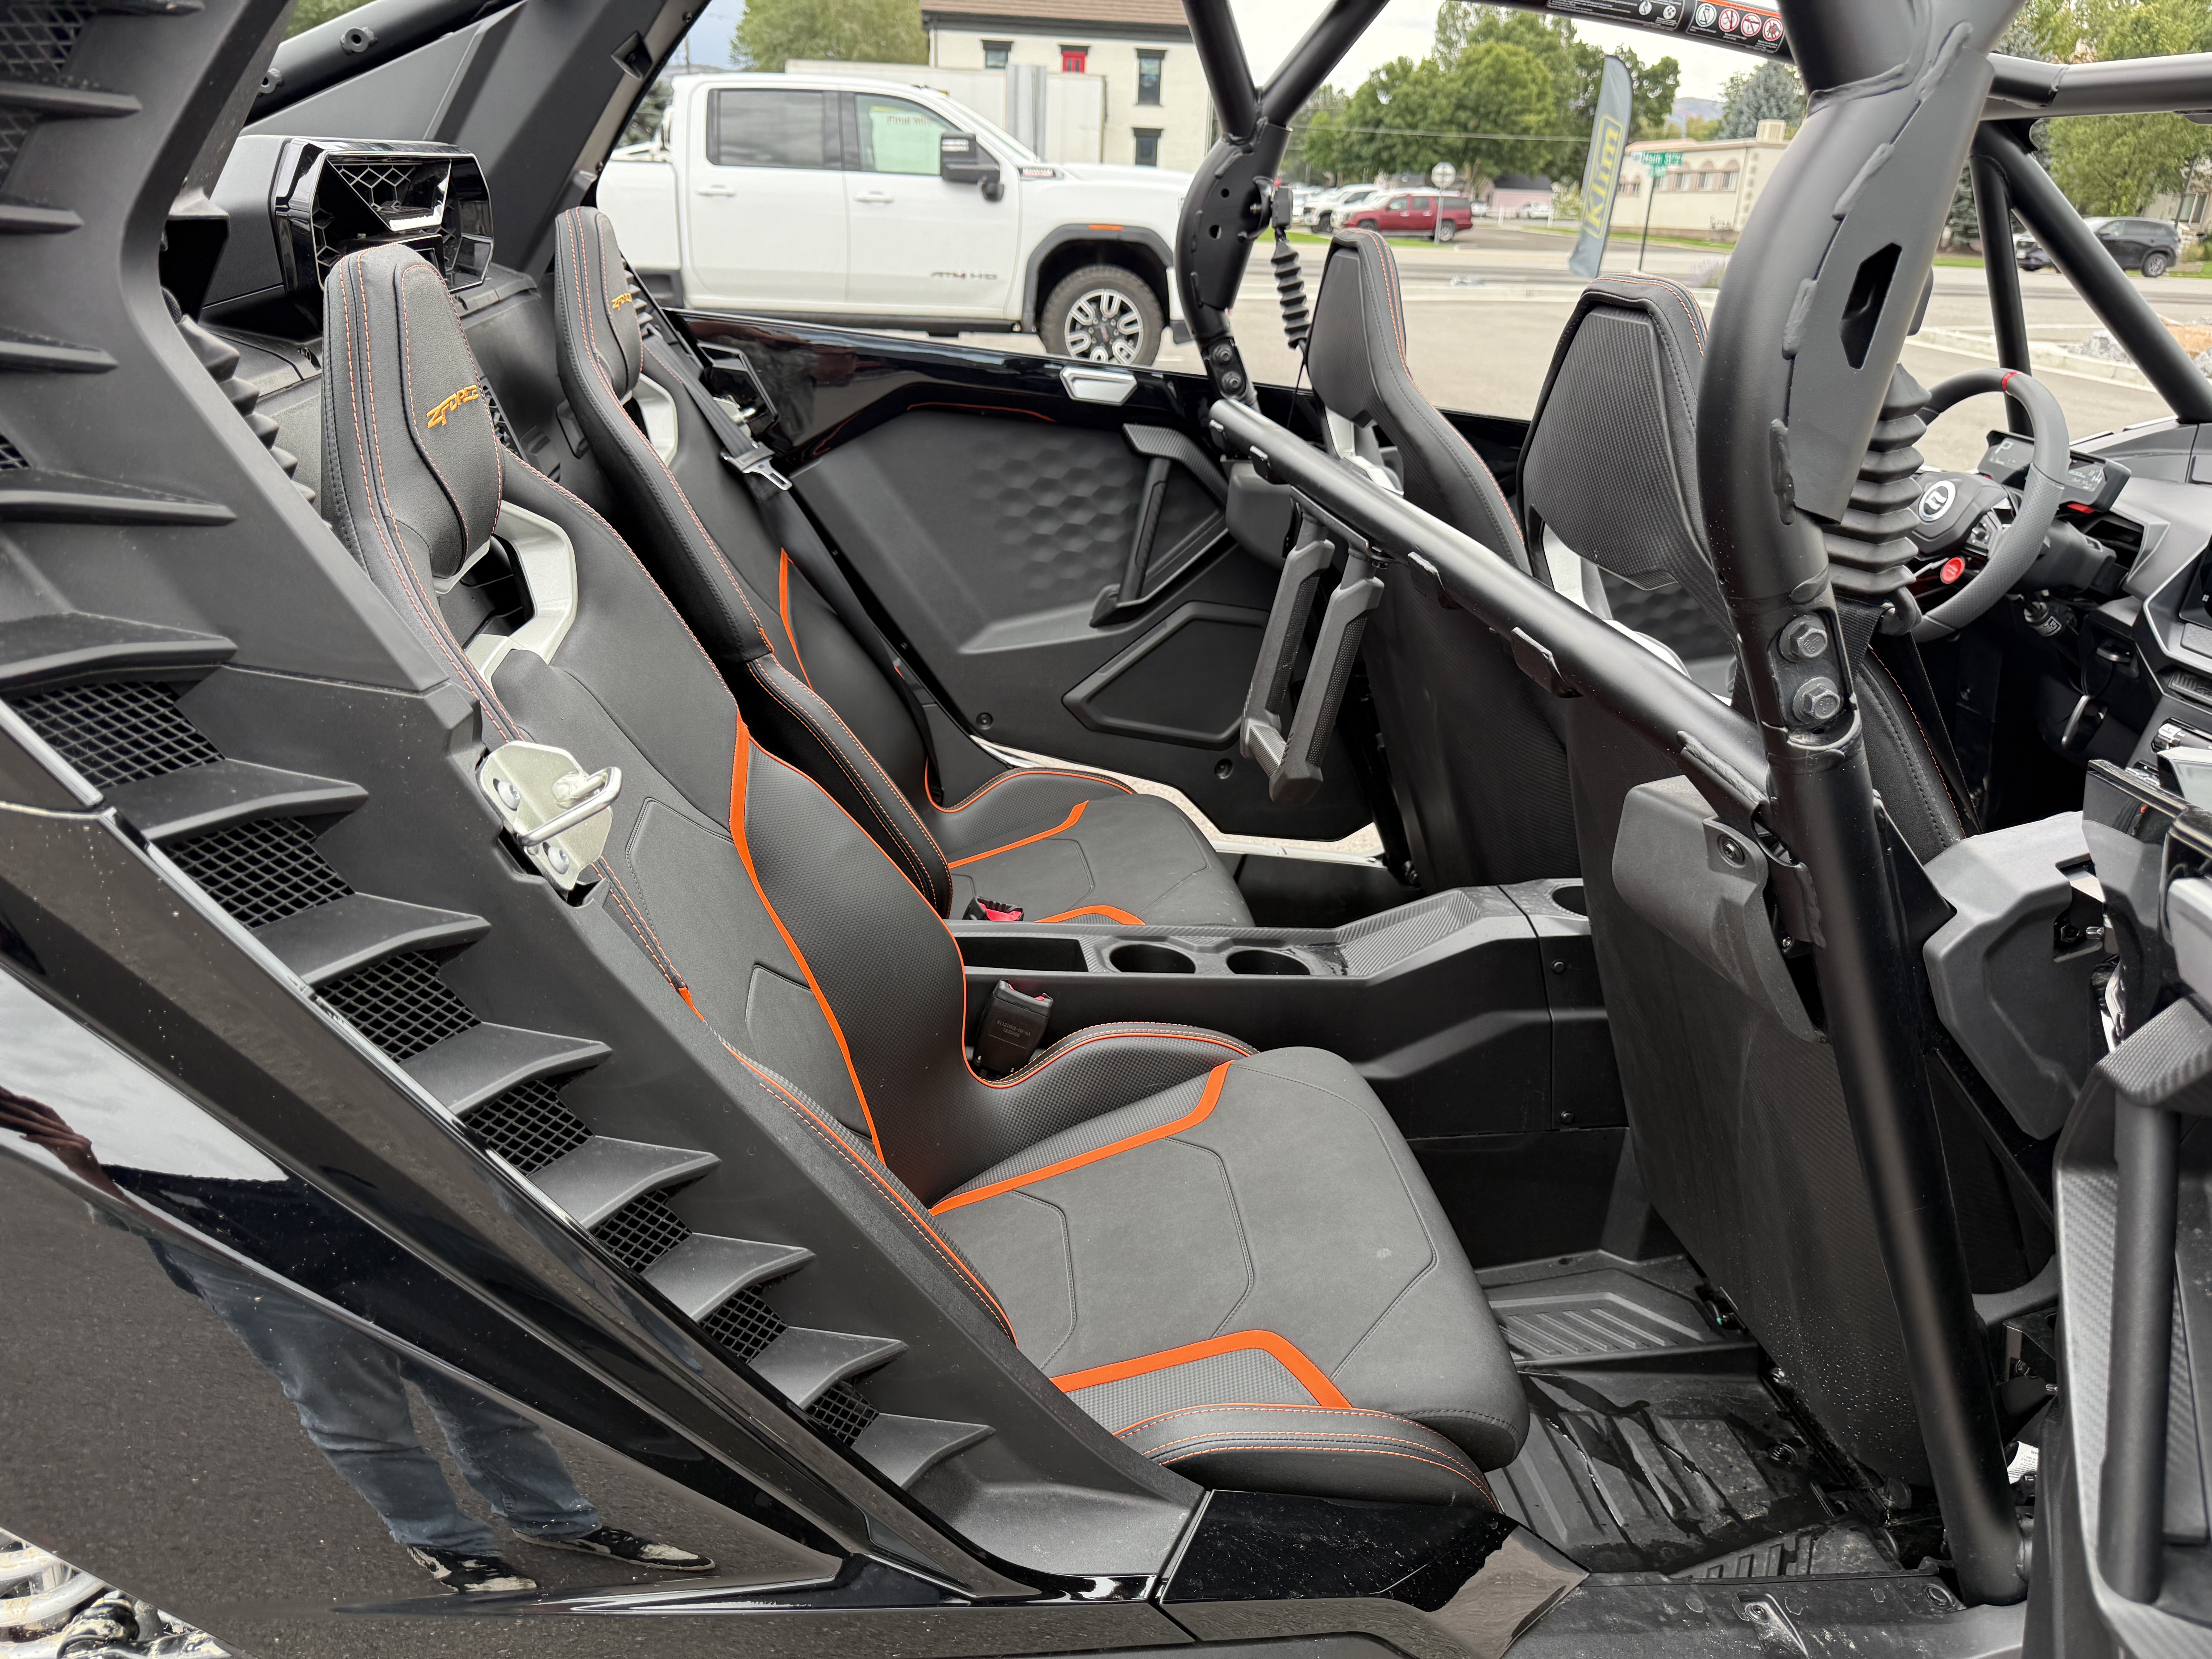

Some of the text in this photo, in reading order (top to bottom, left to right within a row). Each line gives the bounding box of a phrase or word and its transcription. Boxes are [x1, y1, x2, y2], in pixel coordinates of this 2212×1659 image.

[1731, 4, 1756, 12] WARNING
[1643, 152, 1661, 164] Main
[426, 385, 480, 428] ZFORCE
[1995, 440, 2014, 454] P
